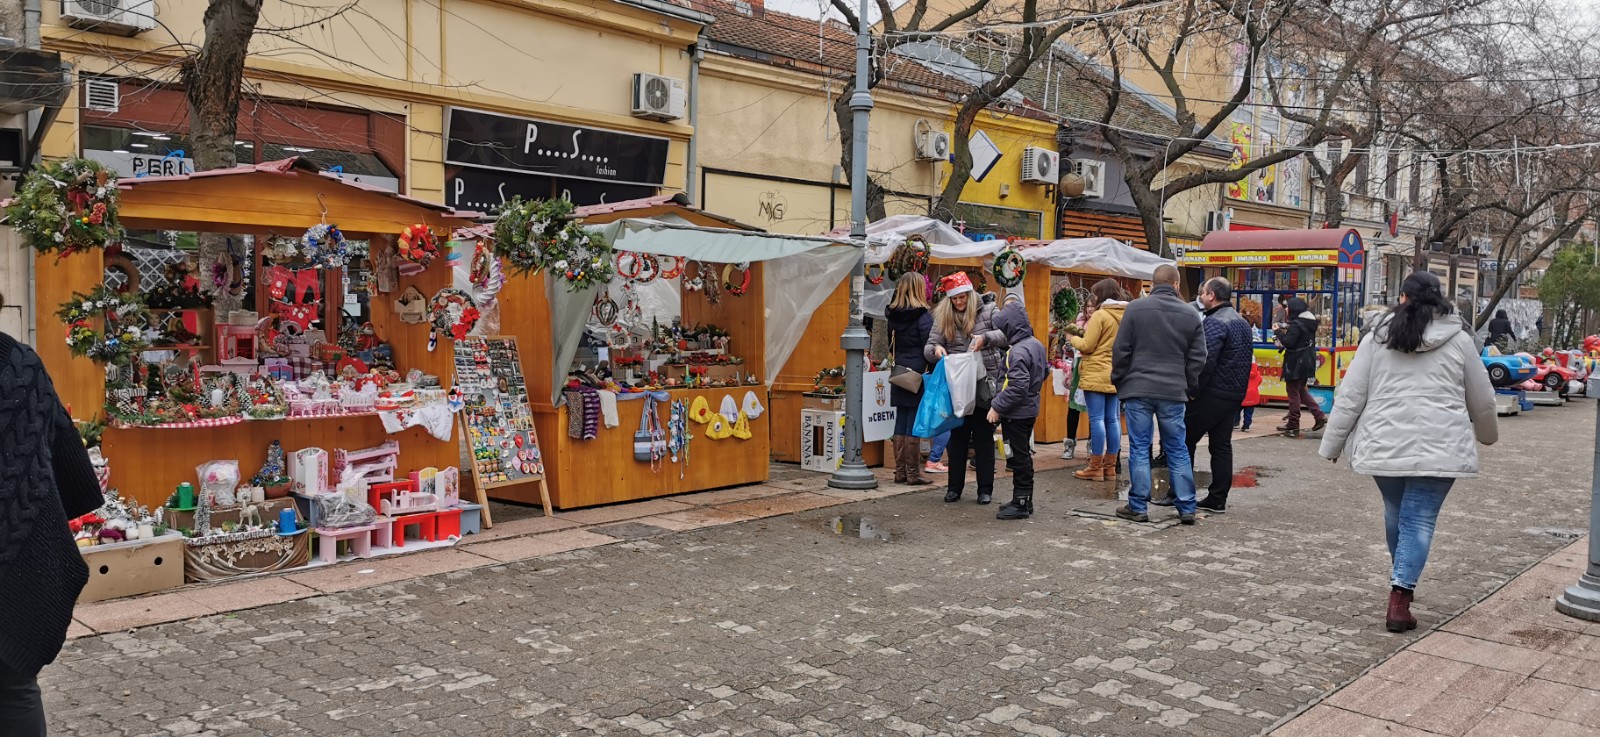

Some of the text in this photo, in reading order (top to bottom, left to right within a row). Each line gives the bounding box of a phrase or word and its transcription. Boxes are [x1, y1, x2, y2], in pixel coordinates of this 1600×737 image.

[596, 165, 616, 176] fashion
[804, 415, 812, 466] BANANAS
[826, 421, 834, 461] BONITA
